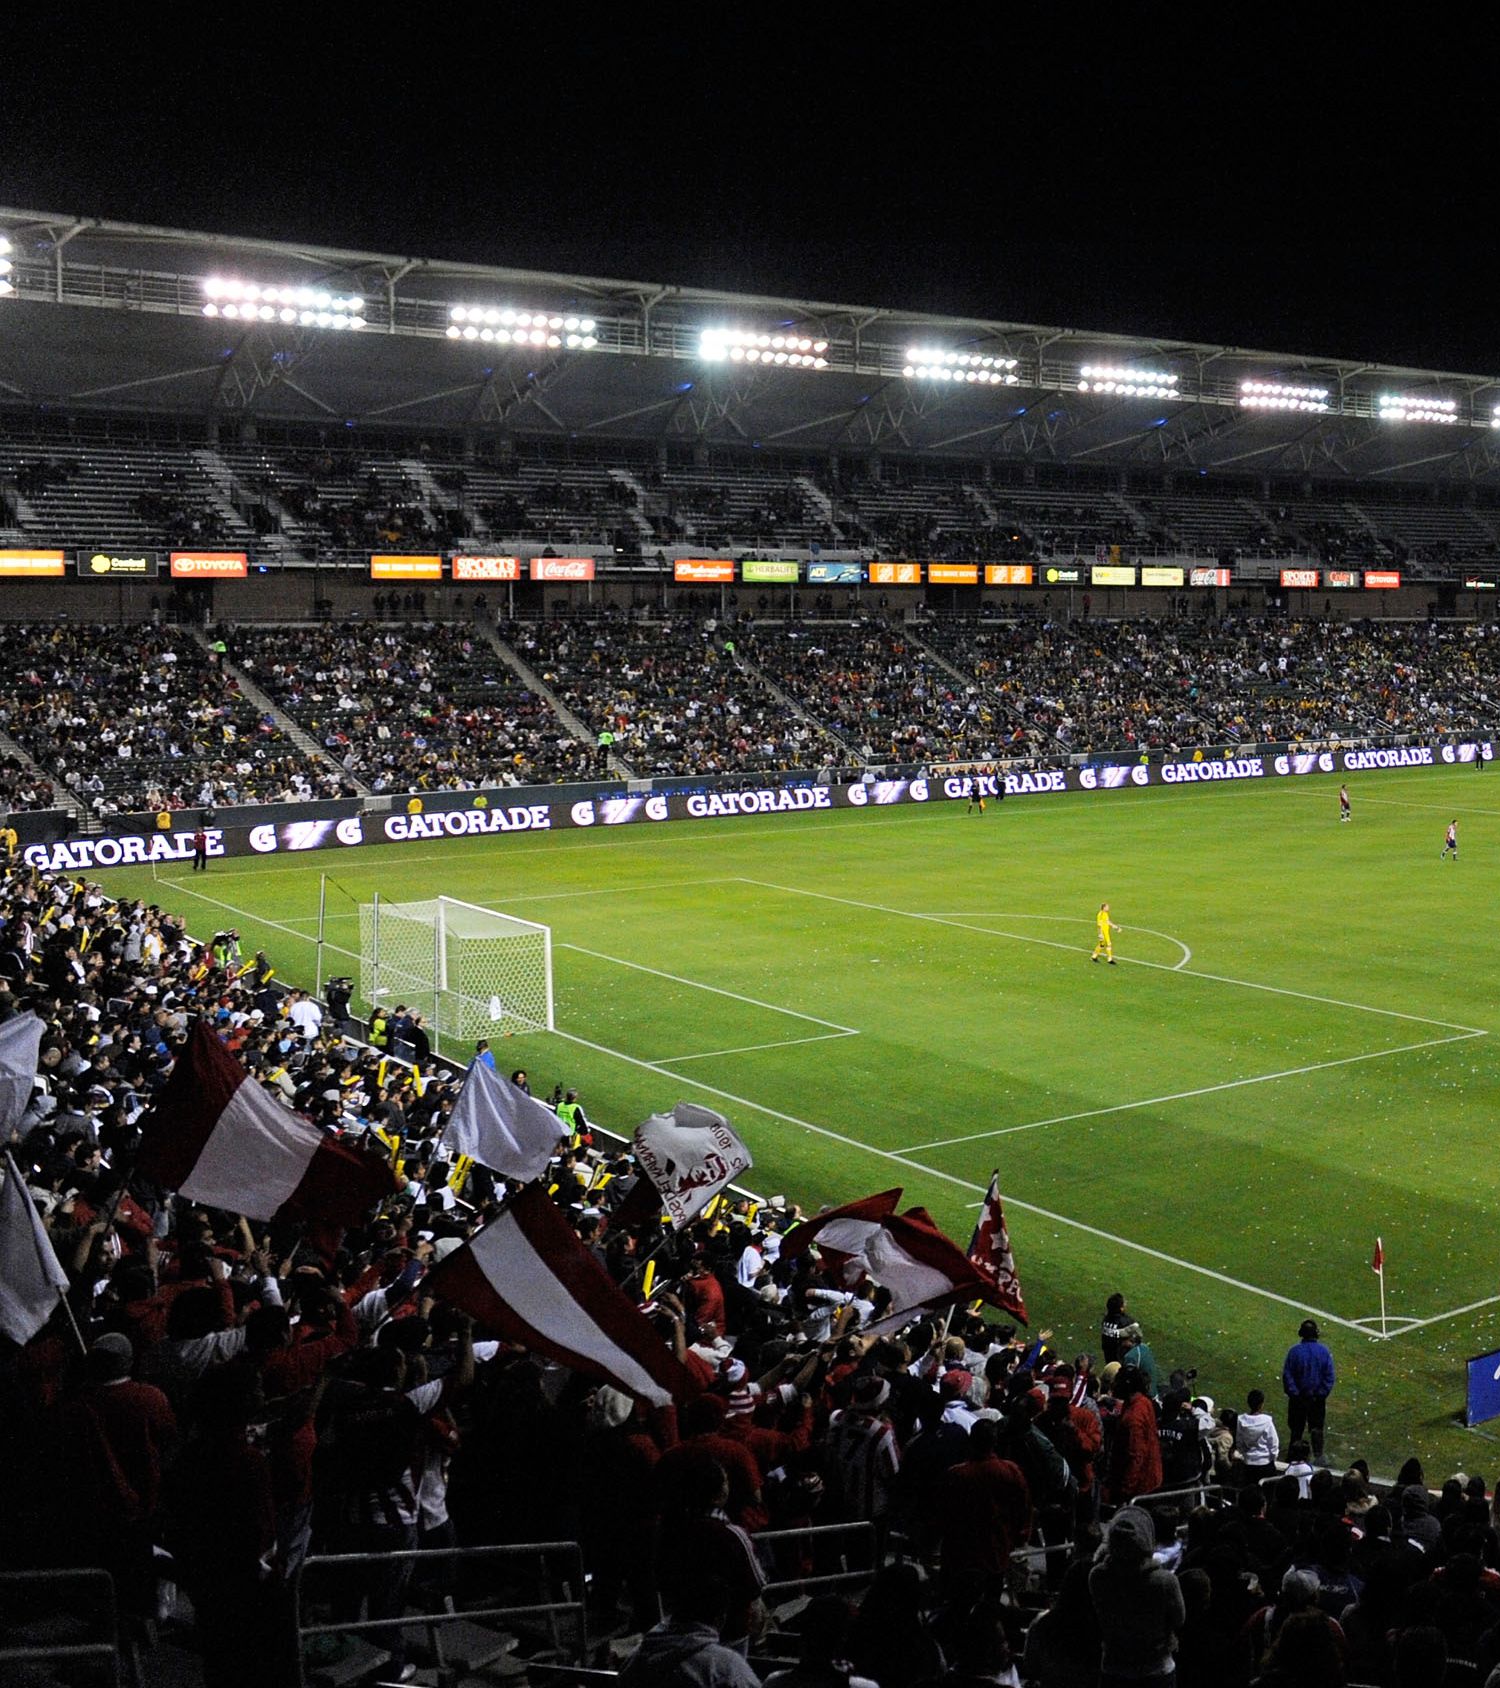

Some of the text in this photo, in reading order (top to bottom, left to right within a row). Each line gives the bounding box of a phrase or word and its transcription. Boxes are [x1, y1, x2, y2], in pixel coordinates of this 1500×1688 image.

[194, 560, 243, 570] TOYOTA
[457, 558, 516, 571] SPORTS
[755, 565, 794, 574] HERBALIFE
[457, 570, 515, 578] AUTHORITY
[810, 567, 826, 577] ADT
[1283, 571, 1316, 580] SPORTS
[1344, 747, 1433, 769] GATORADE
[1161, 758, 1263, 783] GATORADE
[687, 786, 831, 817] GATORADE
[384, 806, 550, 840] GATORADE
